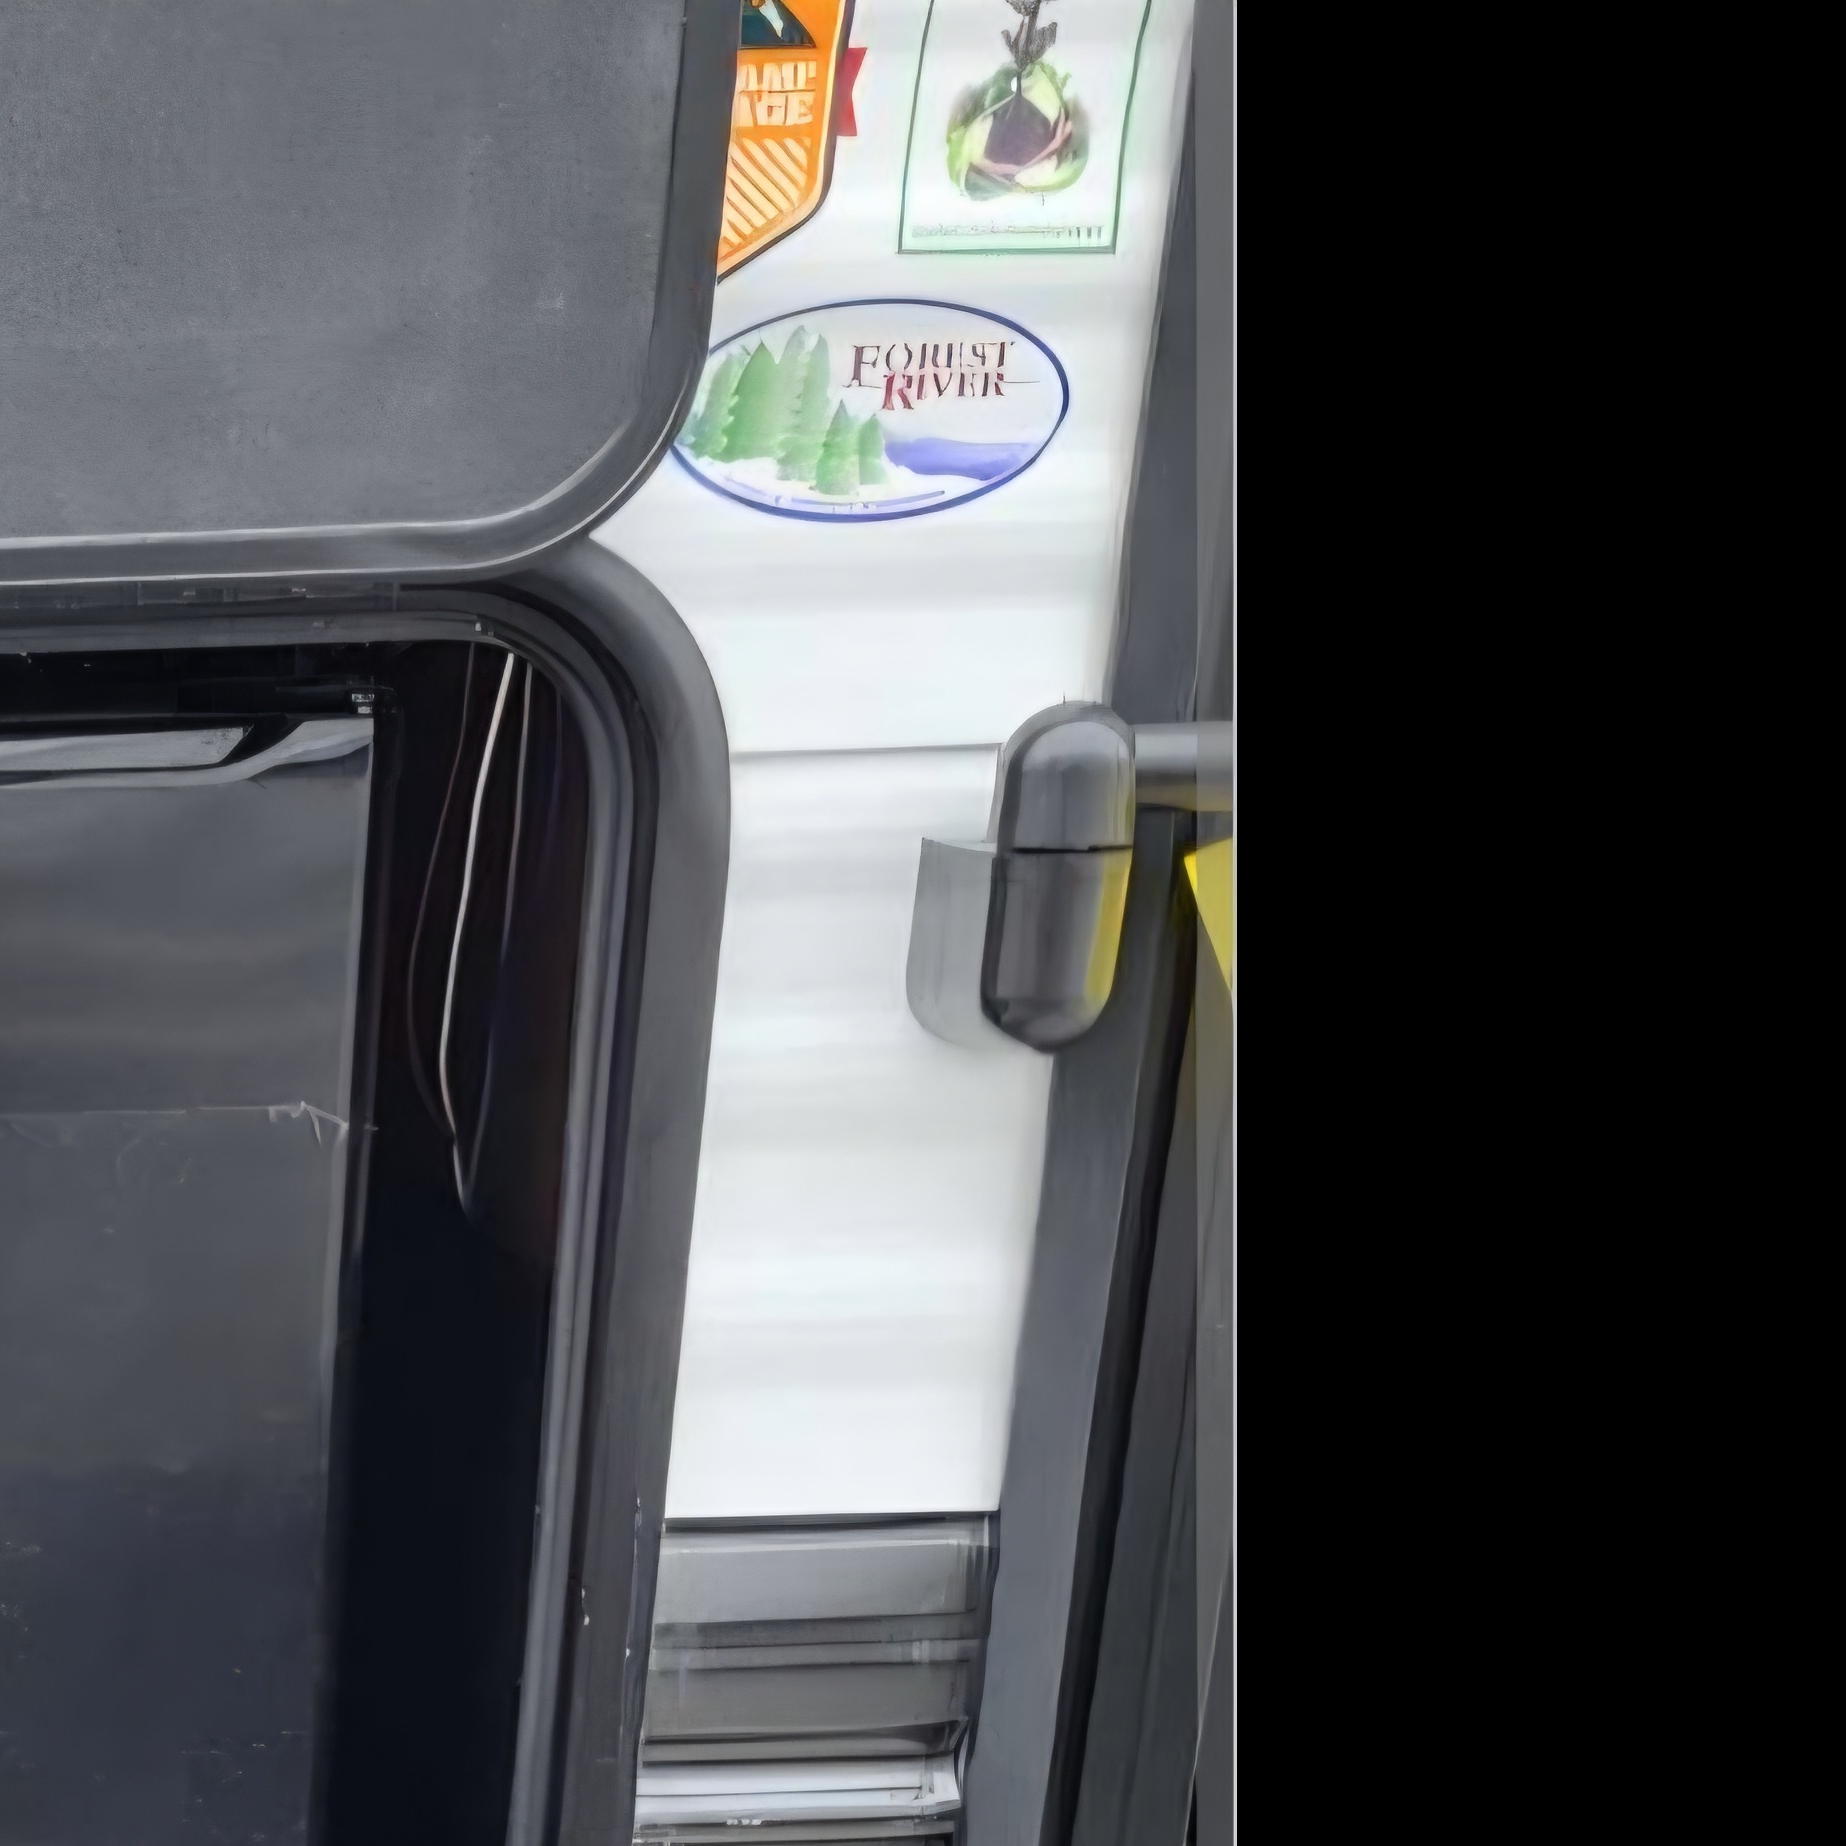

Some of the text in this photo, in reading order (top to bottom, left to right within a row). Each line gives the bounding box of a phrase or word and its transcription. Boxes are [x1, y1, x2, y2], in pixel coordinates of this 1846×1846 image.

[737, 60, 817, 91] AMP
[732, 93, 815, 127] AGE
[879, 370, 1005, 410] RIVER
